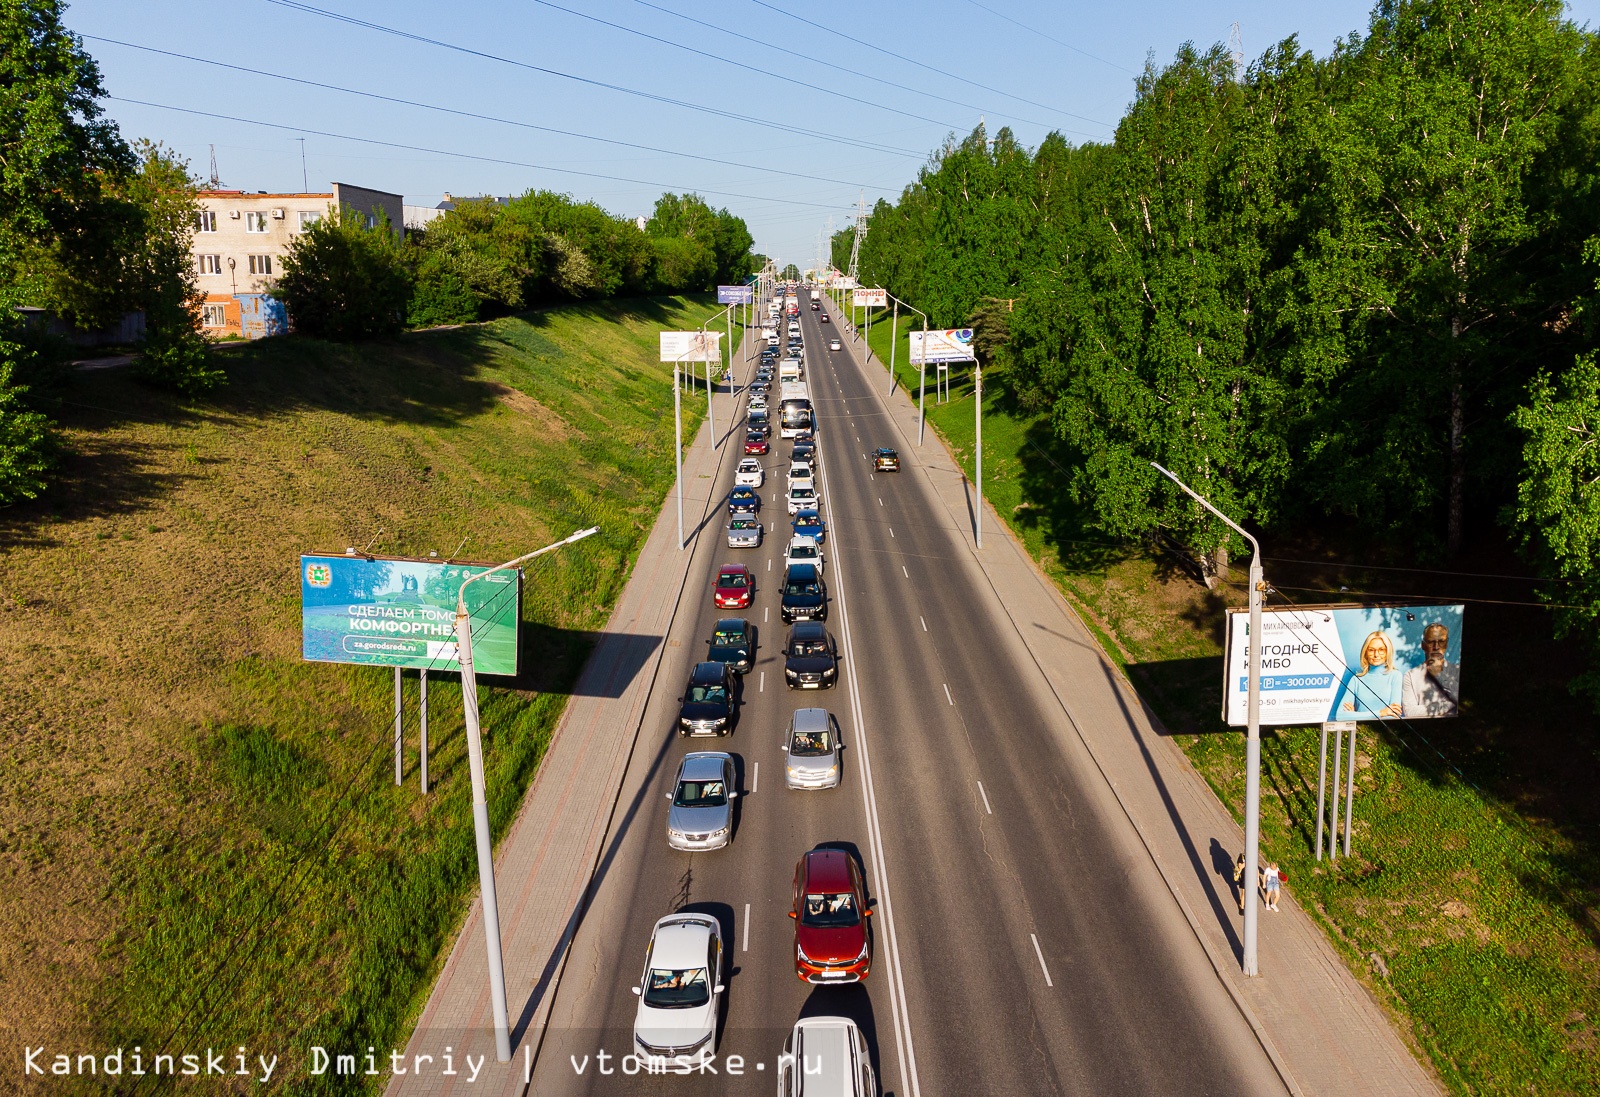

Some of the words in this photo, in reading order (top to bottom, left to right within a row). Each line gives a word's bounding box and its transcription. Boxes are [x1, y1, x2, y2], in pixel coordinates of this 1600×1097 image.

[348, 605, 415, 619] СДЕЛАЕМ
[419, 609, 458, 622] ТОМС
[349, 617, 458, 636] КОМФОРТНЕ
[353, 640, 416, 652] za.gorodsreda.ru
[1244, 658, 1291, 669] КМБО
[1242, 698, 1277, 707] 20-50
[1283, 697, 1330, 705] mikhaylovsky.ru
